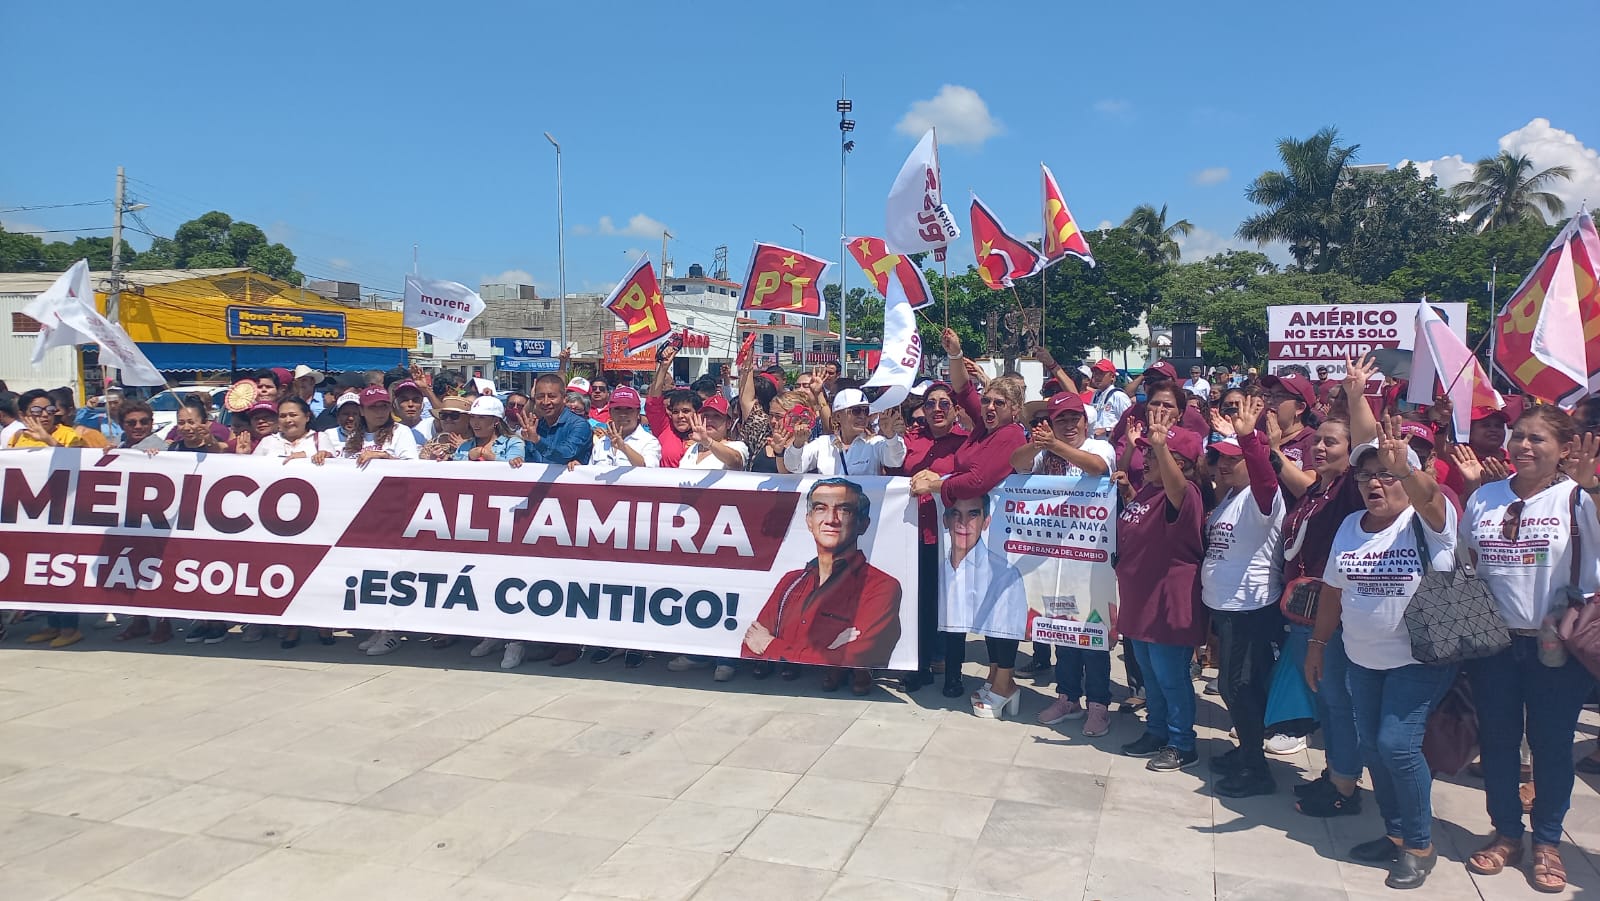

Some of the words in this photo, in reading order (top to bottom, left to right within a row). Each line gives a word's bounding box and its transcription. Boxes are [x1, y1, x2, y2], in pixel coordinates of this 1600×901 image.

[751, 271, 811, 308] PT
[421, 294, 471, 312] morena
[615, 282, 658, 333] PT
[1288, 307, 1397, 326] AMÉRICO
[239, 322, 269, 335] Don
[272, 323, 338, 337] Francisco
[1284, 329, 1305, 339] NO
[1310, 327, 1354, 339] ESTÁS
[1358, 328, 1397, 339] SOLO
[523, 340, 545, 350] ACCESS
[1005, 500, 1030, 515] DR.
[1035, 501, 1108, 521] AMÉRICO
[401, 492, 754, 557] ALTAMIRA
[1005, 515, 1067, 529] VILLARREAL
[1070, 521, 1108, 532] ANAYA
[1005, 527, 1108, 543] GOBERNADOR
[1018, 544, 1060, 555] ESPERANZA
[1074, 550, 1104, 559] CAMBIO
[1363, 549, 1416, 559] AMÉRICO
[1481, 553, 1521, 562] morena
[24, 547, 162, 591] ESTÁS
[173, 559, 295, 598] SOLO
[343, 565, 479, 611] ¡ESTÁ
[494, 577, 739, 631] CONTIGO!
[1036, 630, 1076, 641] morena
